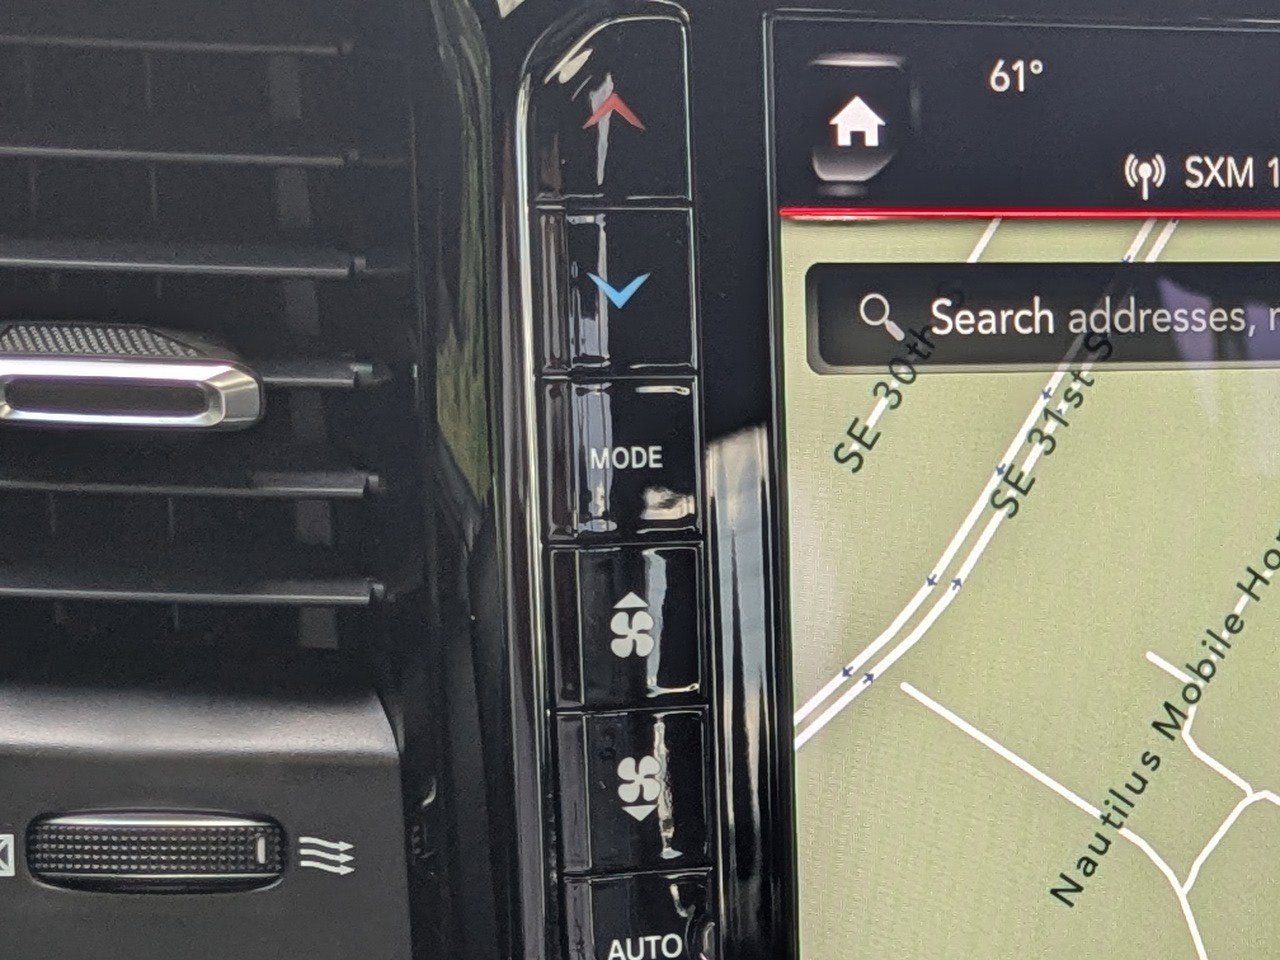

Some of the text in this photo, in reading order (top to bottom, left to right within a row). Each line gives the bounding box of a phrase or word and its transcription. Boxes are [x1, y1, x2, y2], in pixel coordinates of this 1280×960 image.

[989, 59, 1043, 92] 61°
[1185, 155, 1280, 189] SXM 1
[931, 295, 1055, 336] Search
[1068, 296, 1257, 337] addresses,
[590, 446, 663, 470] MODE
[834, 417, 881, 474] SE
[990, 464, 1036, 519] SE
[1028, 367, 1095, 456] 31st
[1050, 751, 1161, 908] Nautilus
[1151, 613, 1245, 741] Mobile
